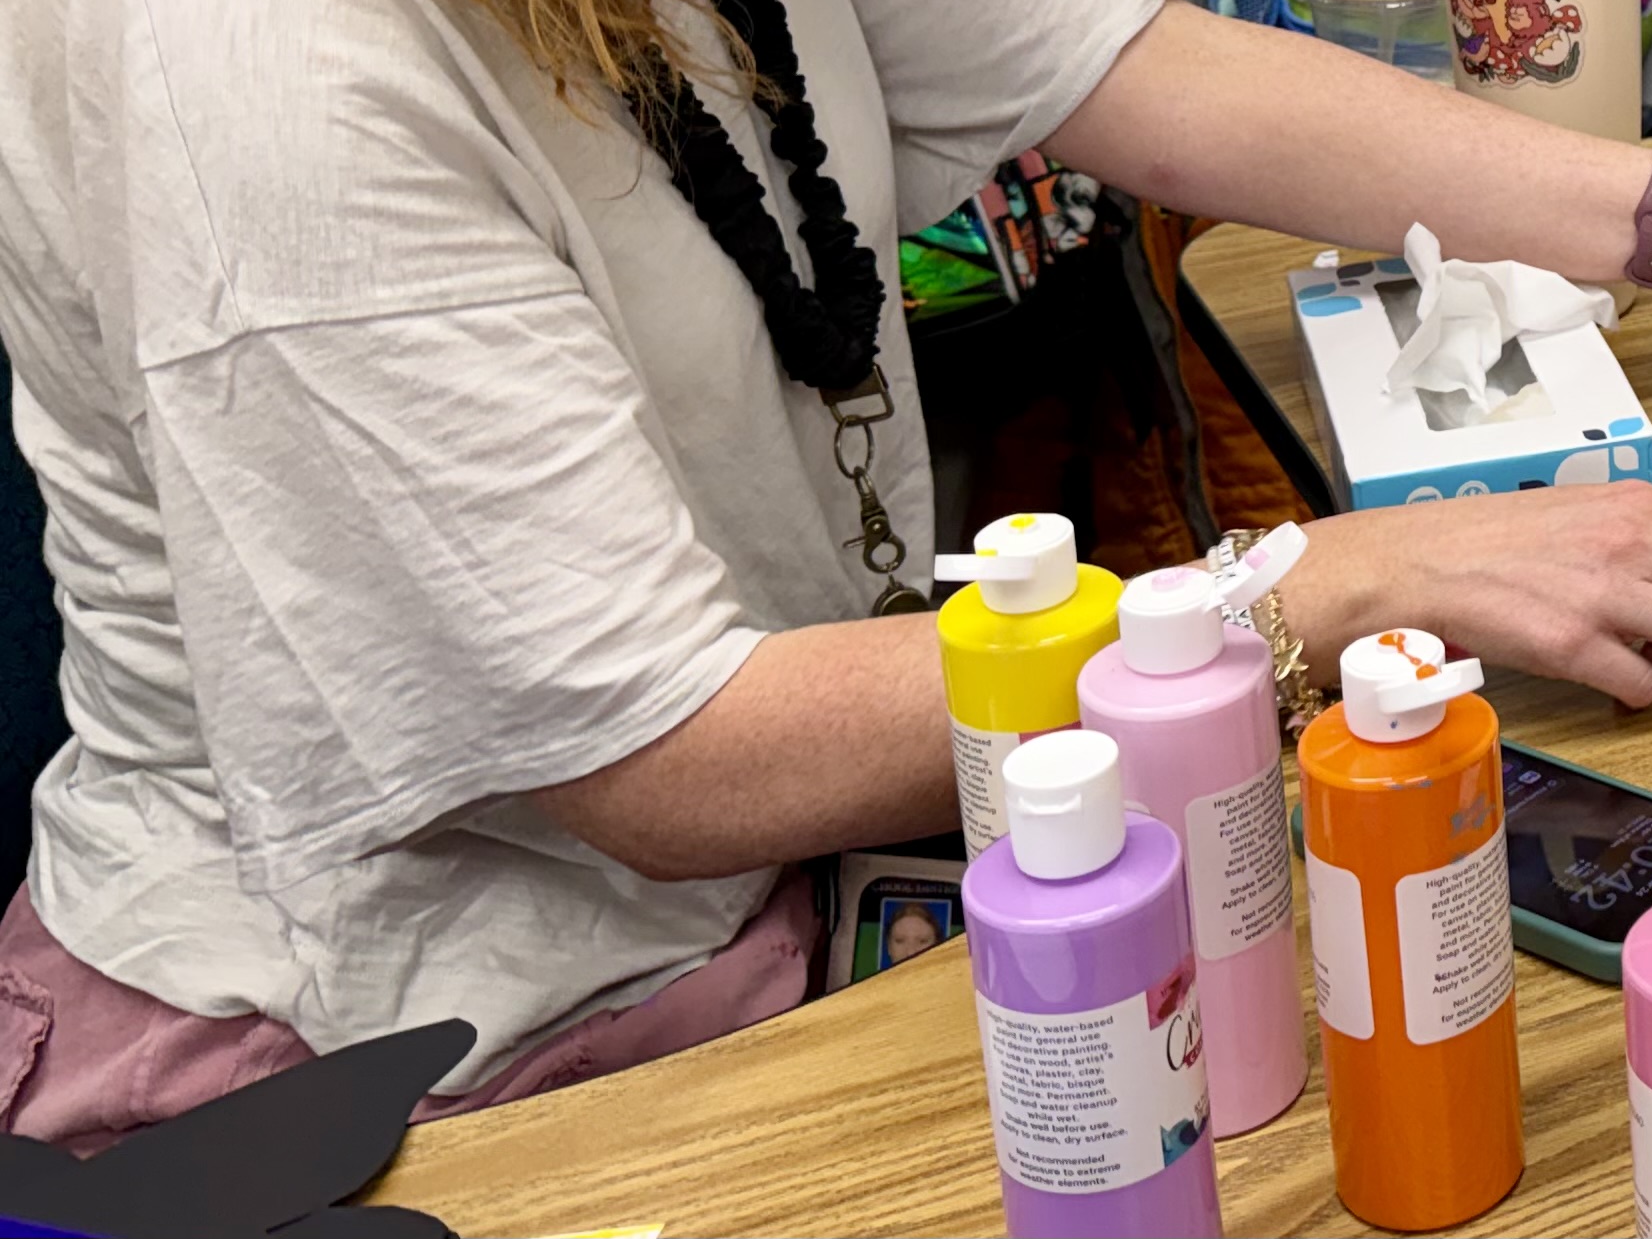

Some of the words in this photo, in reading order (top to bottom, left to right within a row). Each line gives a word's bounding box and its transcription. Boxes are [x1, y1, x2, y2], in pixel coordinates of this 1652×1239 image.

[1440, 881, 1462, 897] paint
[1222, 896, 1246, 909] Apply
[1432, 897, 1450, 909] and
[1432, 910, 1446, 920] For
[1449, 902, 1465, 914] use
[1440, 938, 1457, 950] and
[1436, 949, 1459, 961] Soap
[1433, 981, 1458, 994] Apply
[1453, 996, 1468, 1008] Not
[1044, 1016, 1114, 1034] water-based
[1442, 1014, 1454, 1023] for
[1036, 1035, 1077, 1046] general
[1080, 1033, 1100, 1042] use
[1062, 1042, 1111, 1057] painting.
[1039, 1059, 1071, 1068] wood,
[1075, 1052, 1114, 1066] artist's
[1067, 1078, 1105, 1090] bisque
[1040, 1103, 1069, 1111] water
[1073, 1097, 1118, 1111] cleanup
[1052, 1124, 1086, 1133] before
[1064, 1136, 1081, 1146] dry
[1085, 1129, 1128, 1143] surface.
[1032, 1154, 1105, 1165] recommended
[1077, 1163, 1121, 1176] extreme
[1058, 1177, 1109, 1187] elements.
